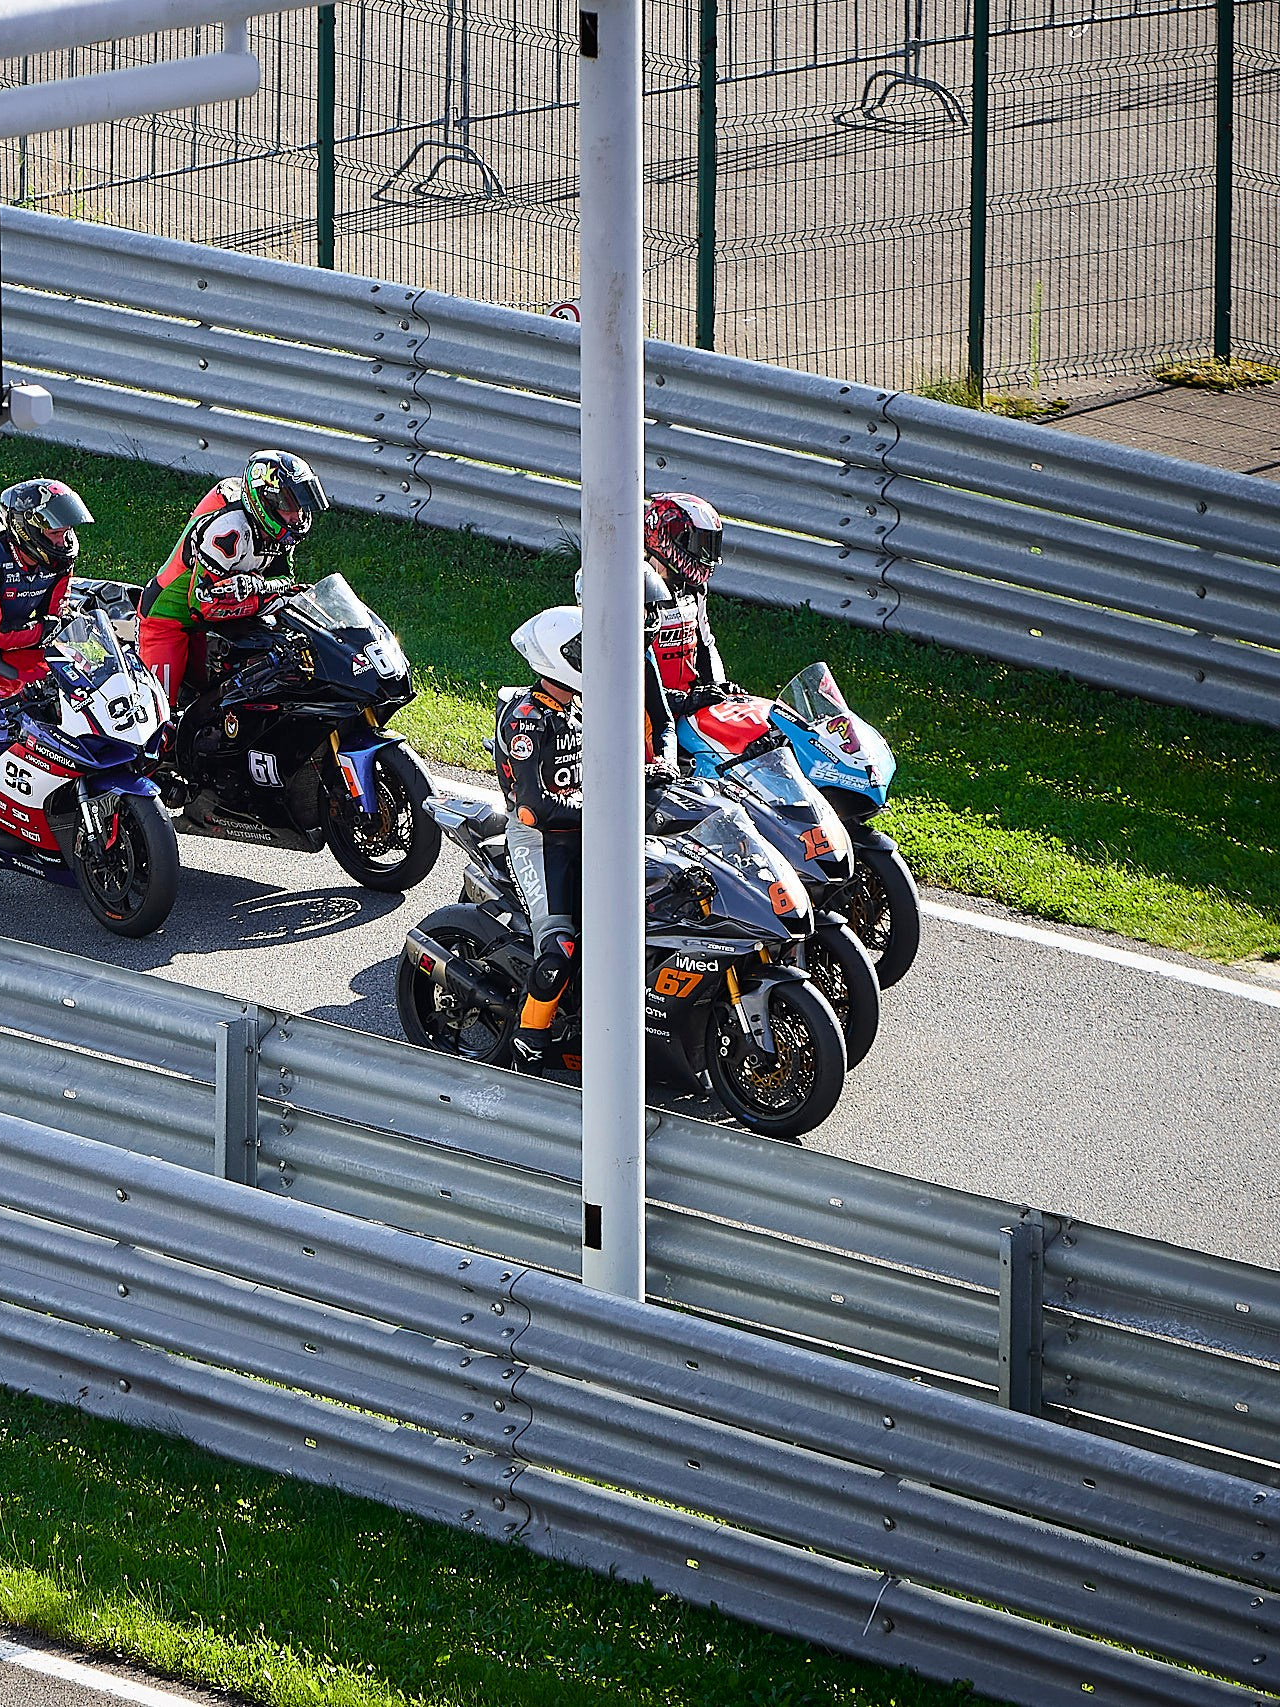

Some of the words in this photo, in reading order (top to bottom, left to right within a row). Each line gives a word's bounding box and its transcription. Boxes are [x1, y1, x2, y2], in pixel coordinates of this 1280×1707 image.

[4, 760, 33, 796] 96
[248, 750, 284, 787] 61
[654, 967, 704, 998] 67
